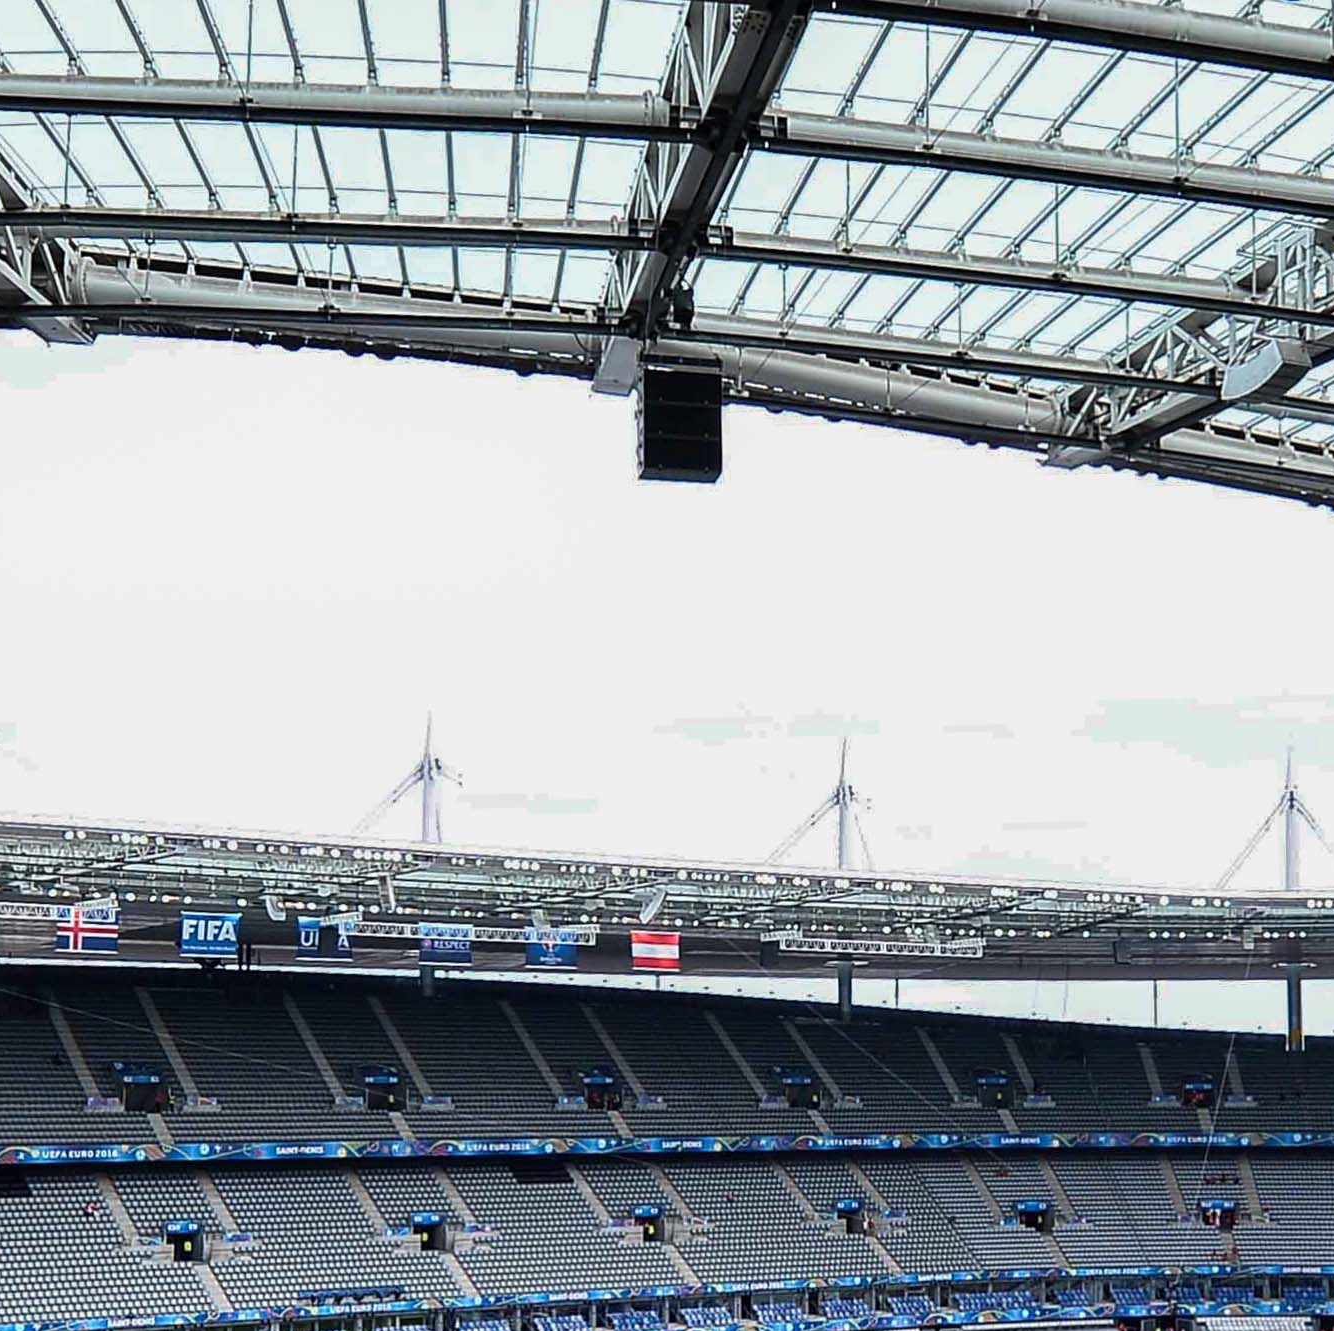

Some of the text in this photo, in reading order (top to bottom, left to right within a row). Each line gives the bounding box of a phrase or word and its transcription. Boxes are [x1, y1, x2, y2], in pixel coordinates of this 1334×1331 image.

[182, 919, 237, 941] FIFA
[300, 930, 350, 948] UA
[433, 940, 471, 950] RESPECT
[1000, 1137, 1041, 1145] SAINT-DENIS
[1167, 1136, 1226, 1144] UEFA EURO 2016
[276, 1146, 324, 1155] SAINT-DENIS
[512, 1143, 530, 1151] 2016
[41, 1149, 118, 1159] UEFA EURO 2016
[108, 1318, 155, 1328] SAINT-DENIS
